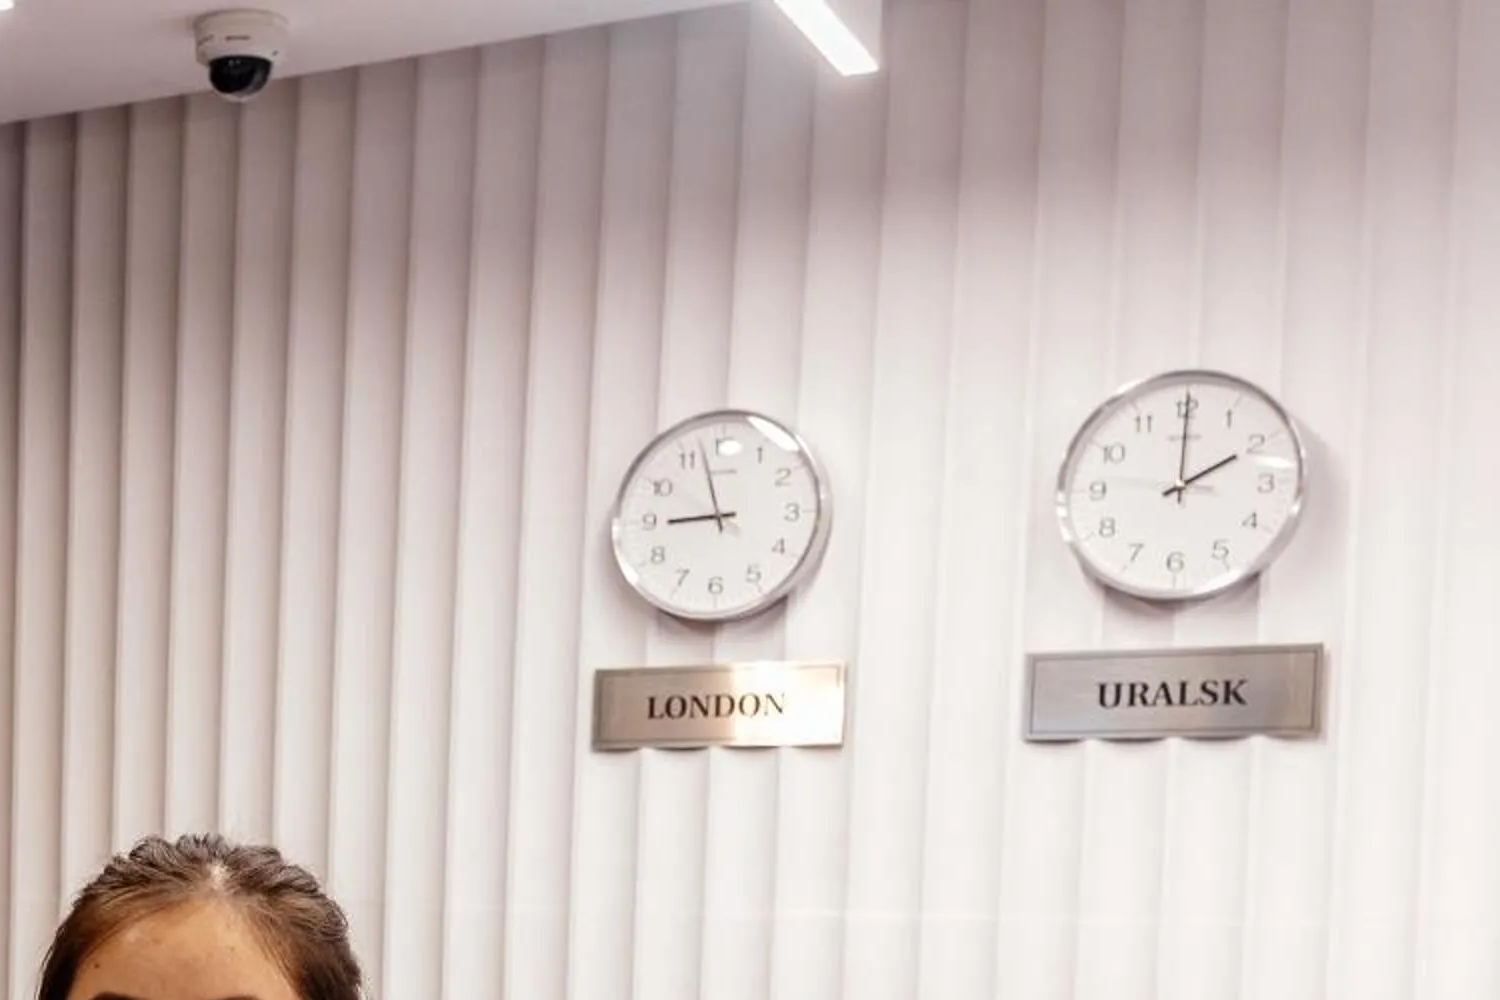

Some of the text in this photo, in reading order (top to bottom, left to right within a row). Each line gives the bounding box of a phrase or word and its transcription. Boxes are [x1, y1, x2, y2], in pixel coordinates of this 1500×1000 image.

[1135, 414, 1153, 433] 11
[1225, 409, 1232, 428] 1
[1102, 443, 1126, 464] 10
[1246, 434, 1266, 455] 2
[678, 451, 695, 470] 11
[756, 446, 763, 464] 1
[774, 467, 791, 486] 2
[1257, 473, 1275, 494] 3
[652, 477, 673, 497] 10
[1089, 481, 1106, 501] 9
[642, 512, 657, 531] 9
[784, 503, 800, 522] 3
[1242, 512, 1258, 529] 4
[1098, 517, 1116, 537] 8
[650, 546, 665, 564] 8
[771, 538, 786, 555] 4
[1128, 543, 1145, 563] 7
[1211, 540, 1230, 560] 5
[1166, 551, 1185, 572] 6
[675, 569, 690, 587] 7
[745, 564, 762, 583] 5
[707, 577, 723, 595] 6
[1096, 679, 1248, 710] URALSK
[646, 691, 787, 721] LONDON
